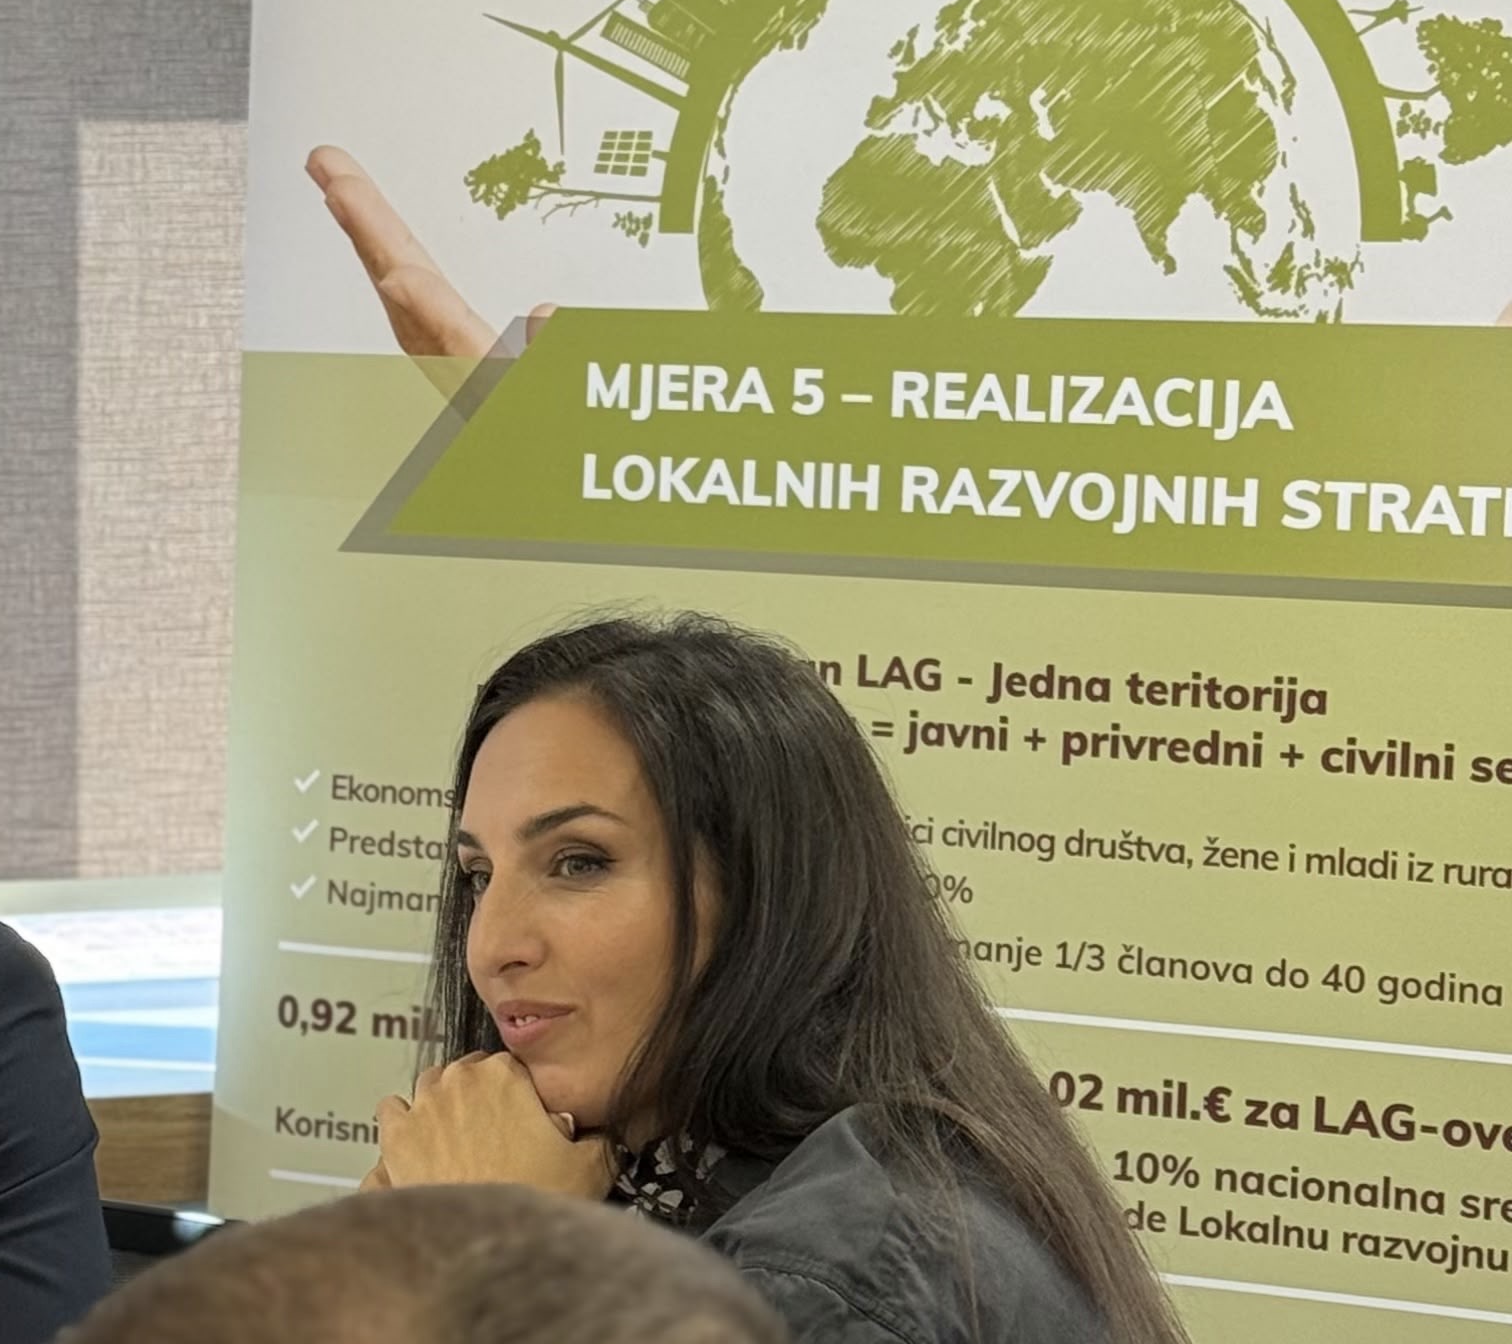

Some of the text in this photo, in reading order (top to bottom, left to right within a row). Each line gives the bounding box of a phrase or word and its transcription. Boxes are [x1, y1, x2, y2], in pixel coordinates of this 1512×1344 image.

[586, 362, 774, 421] MJERA
[791, 368, 825, 415] 5
[891, 370, 1294, 440] REALIZACIJA
[582, 453, 880, 511] LOKALNIH
[901, 466, 1259, 534] RAZVOJNIH
[857, 654, 942, 691] LAG
[986, 661, 1111, 704] Jedna
[1125, 671, 1328, 724] teritorija
[904, 709, 1009, 755] javni
[1061, 722, 1263, 768] privredni
[1321, 736, 1455, 780] civilni
[329, 826, 449, 860] Predsta
[942, 821, 1055, 862] civilnog
[1065, 828, 1193, 869] društva,
[1203, 836, 1279, 871] žene
[1288, 843, 1296, 872] i
[1305, 847, 1397, 880] mladi
[1407, 852, 1434, 883] iz
[1055, 941, 1105, 972] 1/3
[1118, 944, 1253, 985] članova
[1265, 958, 1309, 989] do
[1321, 963, 1365, 994] 40
[1377, 972, 1503, 1007] godina
[278, 994, 357, 1036] 0,92
[1117, 1079, 1232, 1123] mil.€
[1244, 1099, 1299, 1131] za
[1113, 1150, 1200, 1188] 10%
[1215, 1166, 1445, 1216] nacionalna
[1179, 1206, 1328, 1251] Lokalnu
[1342, 1231, 1508, 1275] razvojnu
